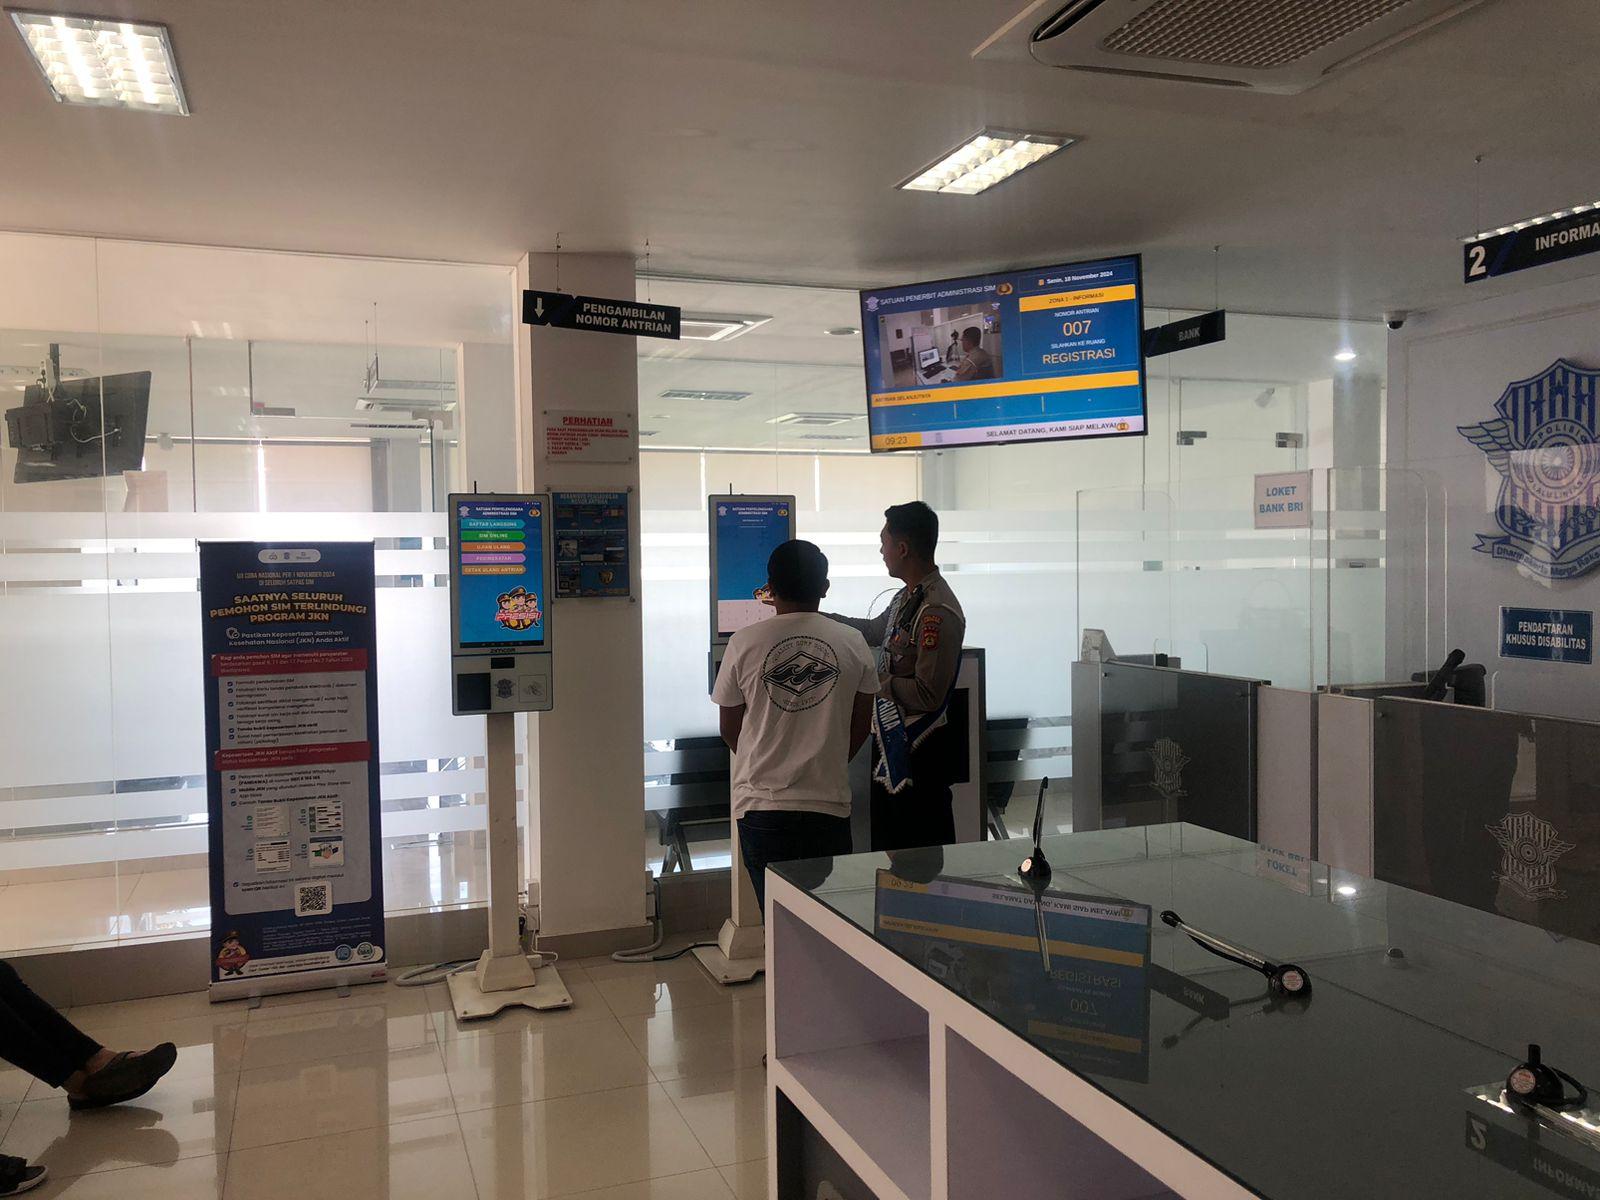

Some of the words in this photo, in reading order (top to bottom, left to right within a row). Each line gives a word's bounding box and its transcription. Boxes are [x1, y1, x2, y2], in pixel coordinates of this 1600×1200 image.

[1469, 245, 1487, 277] 2
[1071, 273, 1099, 281] November
[880, 297, 905, 305] SATUAN
[905, 292, 937, 302] PENERBIT
[937, 287, 983, 298] ADMINISTRASI
[1073, 292, 1104, 301] INFORMASI
[583, 303, 666, 321] PENGAMBILAN
[1075, 307, 1099, 316] ANTRIAN
[576, 314, 619, 328] NOMOR
[621, 318, 672, 333] ANTRIAN
[1063, 320, 1091, 336] 007
[1178, 327, 1201, 341] BANK
[1050, 342, 1077, 350] SILAHKAN
[1086, 338, 1106, 346] RUANG
[1043, 347, 1116, 365] REGISTRASI
[562, 416, 613, 426] PERHATIAN
[986, 430, 1017, 438] SELAMAT
[1018, 427, 1048, 436] DATANG,
[1050, 425, 1067, 433] KAMI
[1068, 424, 1085, 432] SIAP
[1537, 423, 1582, 440] POLISI
[1266, 486, 1297, 497] LOKET
[1259, 503, 1285, 513] BANK
[1287, 502, 1304, 512] BRI
[234, 593, 289, 604] SAATNYA
[291, 592, 344, 602] SELURUH
[209, 601, 268, 618] PEMOHON
[271, 602, 292, 611] SIM
[294, 602, 367, 614] TERLINDUNGI
[250, 612, 306, 622] PROGRAM
[308, 612, 330, 621] JKN
[271, 631, 314, 639] Kepesertaan
[1518, 621, 1574, 635] PENDAFTARAN
[296, 637, 315, 645] (JKN)
[1506, 633, 1536, 646] KHUSUS
[1537, 635, 1586, 650] DISABILITAS
